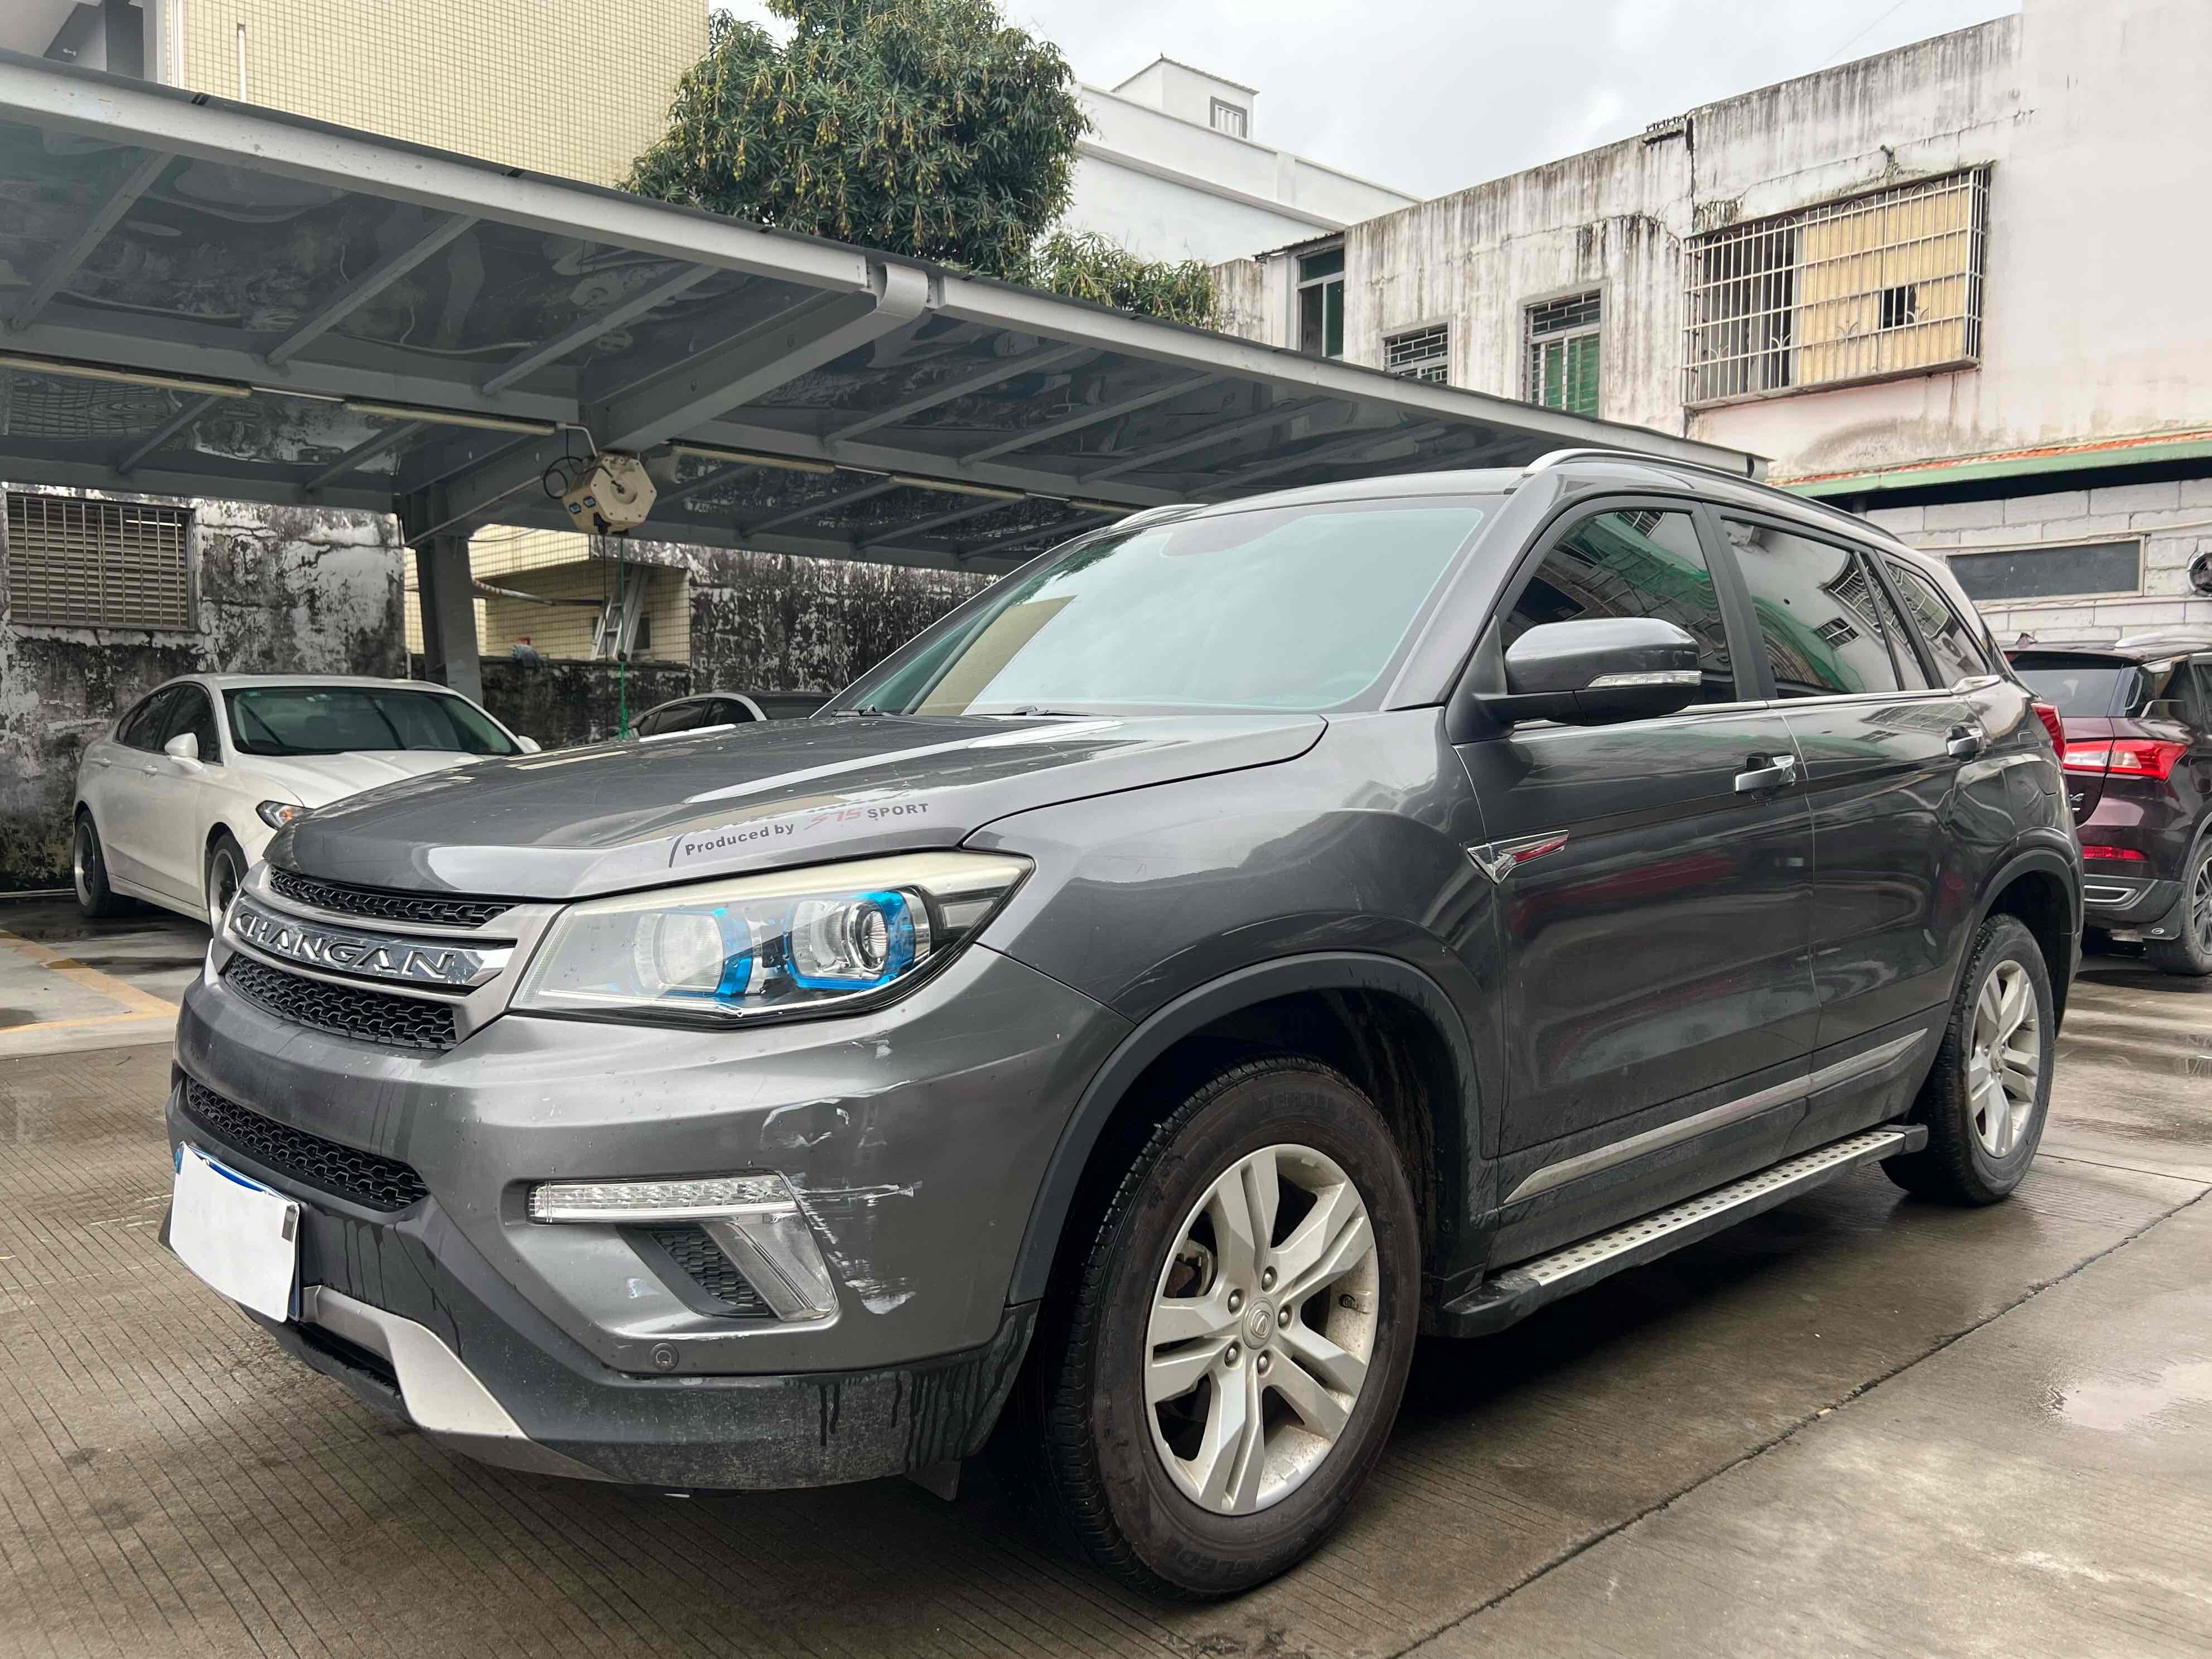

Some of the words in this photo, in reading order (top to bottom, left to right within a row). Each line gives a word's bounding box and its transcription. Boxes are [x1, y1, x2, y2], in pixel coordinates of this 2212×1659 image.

[685, 826, 770, 856] Produced
[775, 823, 794, 835] by
[867, 803, 929, 818] SPORT
[235, 912, 454, 979] CHANGAN
